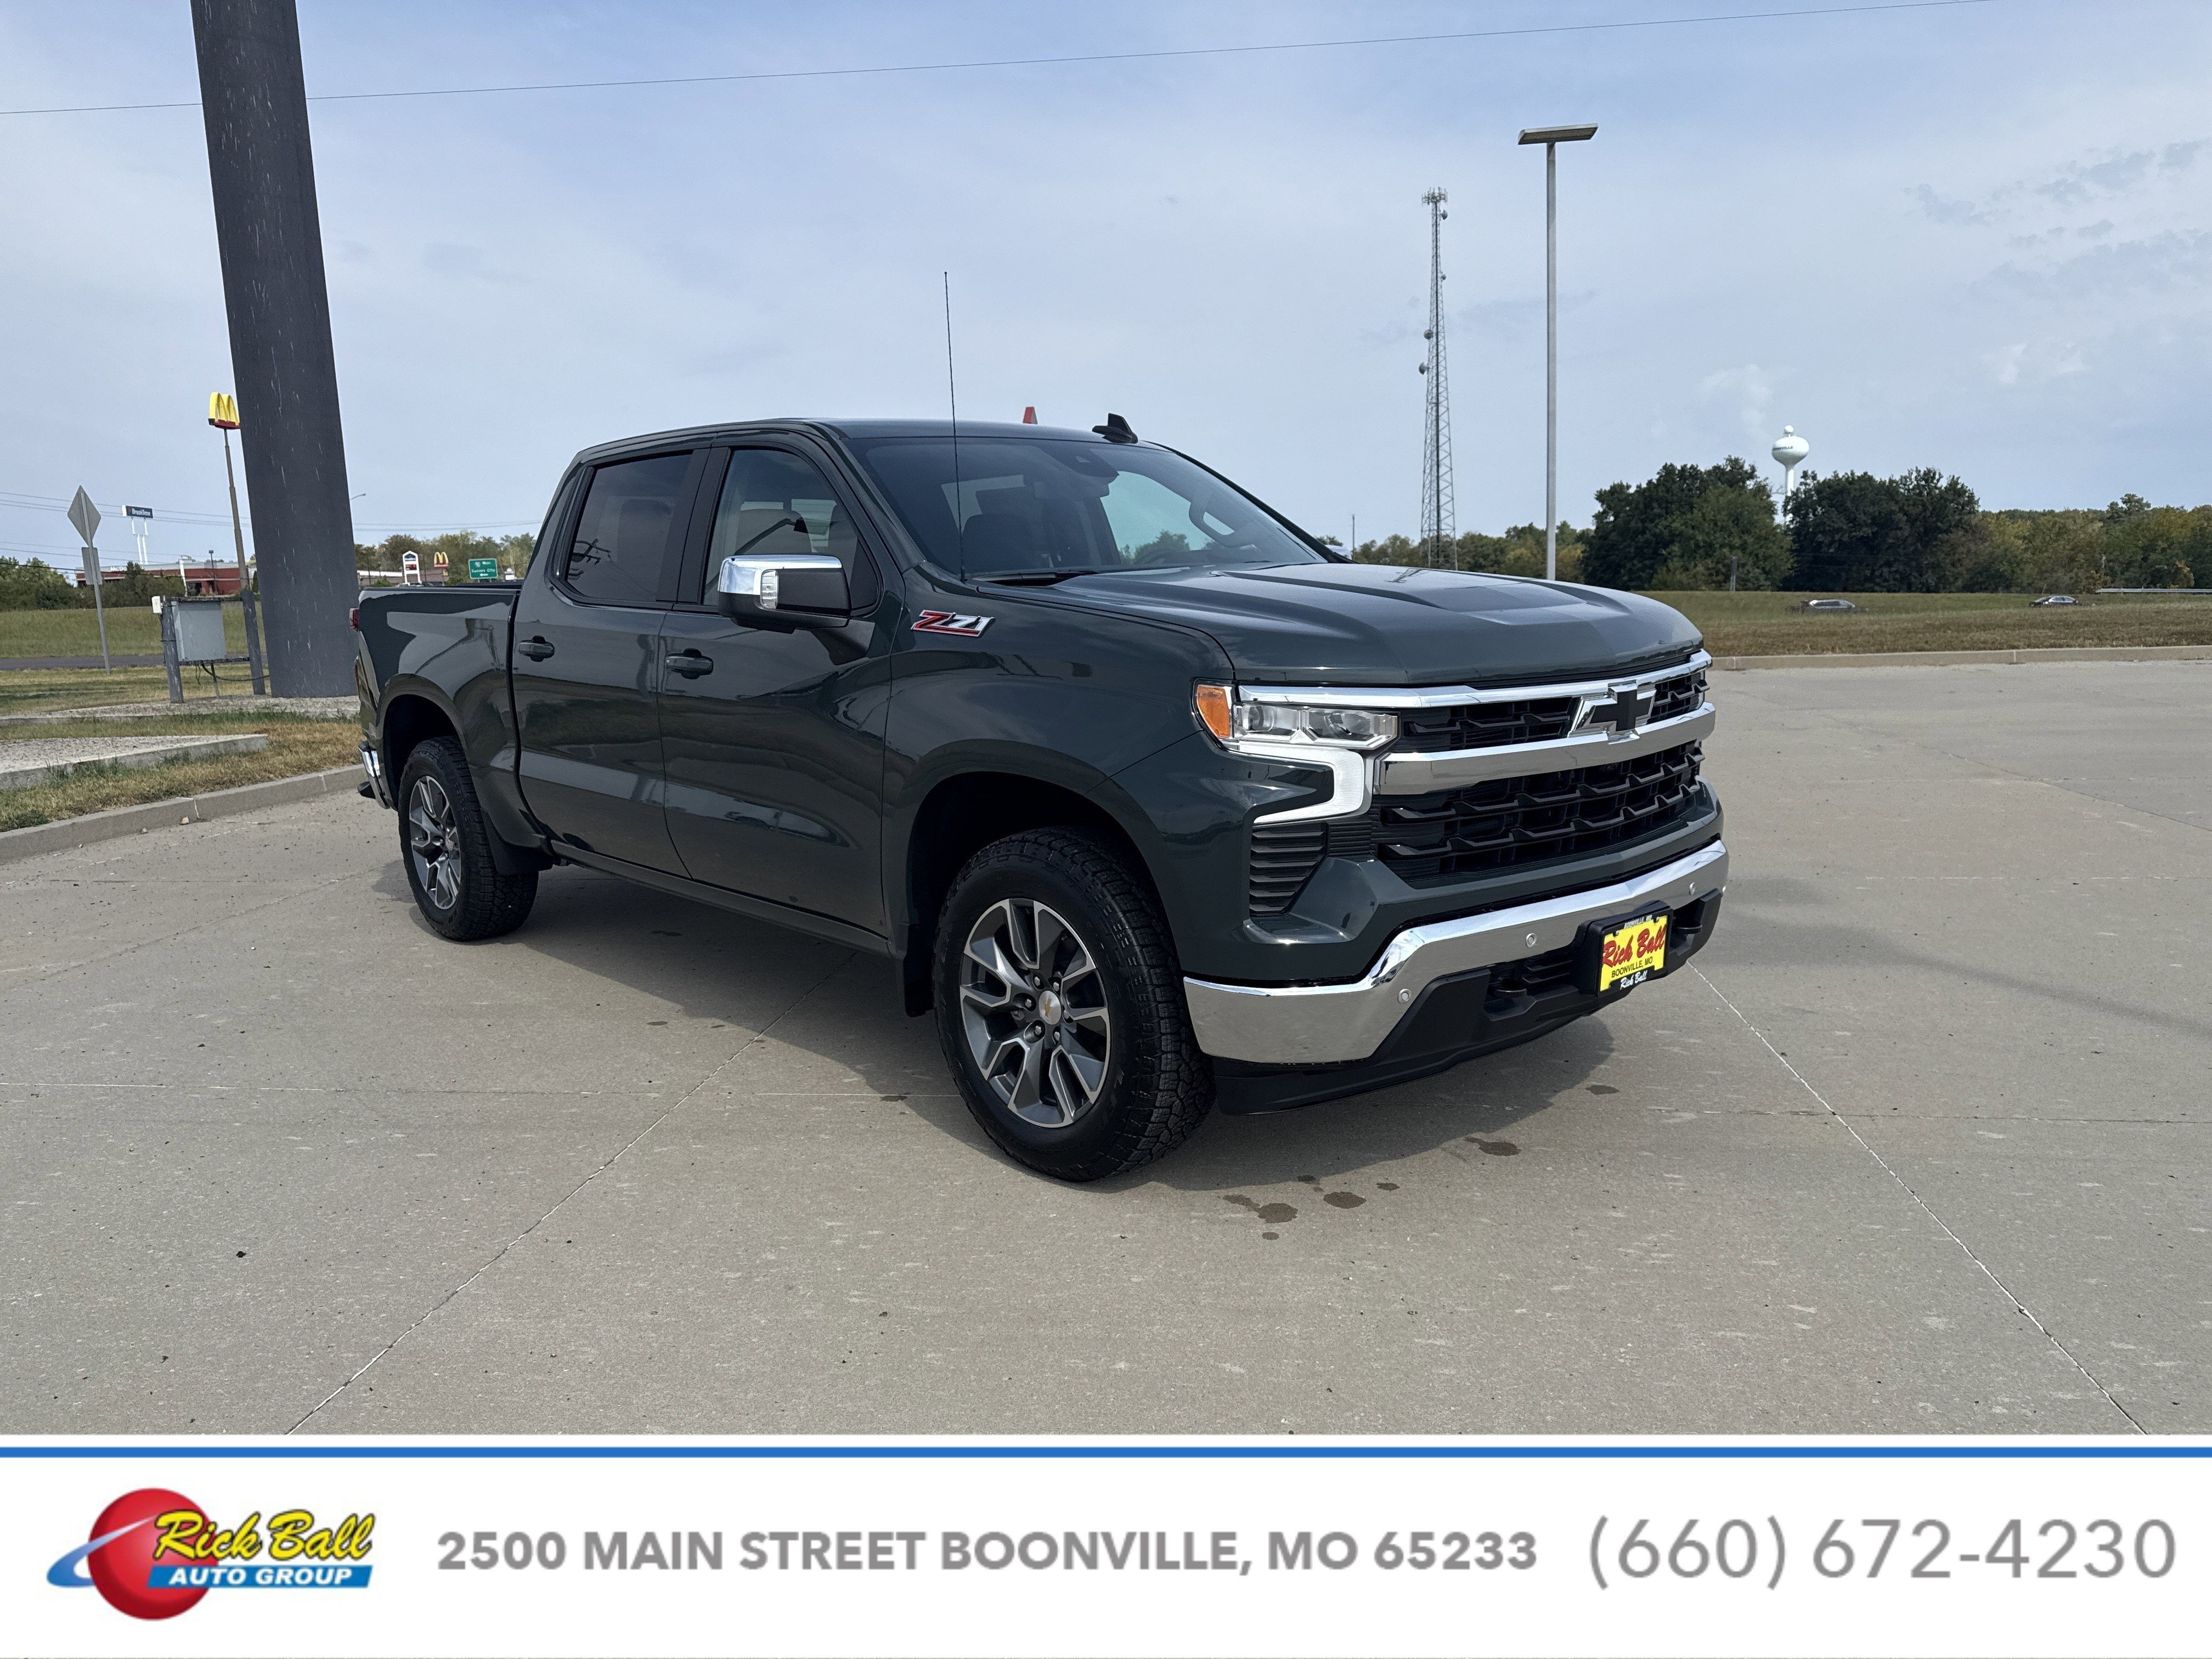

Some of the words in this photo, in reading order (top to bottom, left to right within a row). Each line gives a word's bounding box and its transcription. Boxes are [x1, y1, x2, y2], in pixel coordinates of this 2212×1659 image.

[911, 610, 996, 637] Z71
[1602, 935, 1633, 968] Rick
[1637, 924, 1666, 958] Ball
[1611, 961, 1644, 978] BOONVILLE,
[1645, 956, 1653, 966] MO
[1620, 974, 1634, 990] Rick
[1635, 969, 1647, 984] Ball
